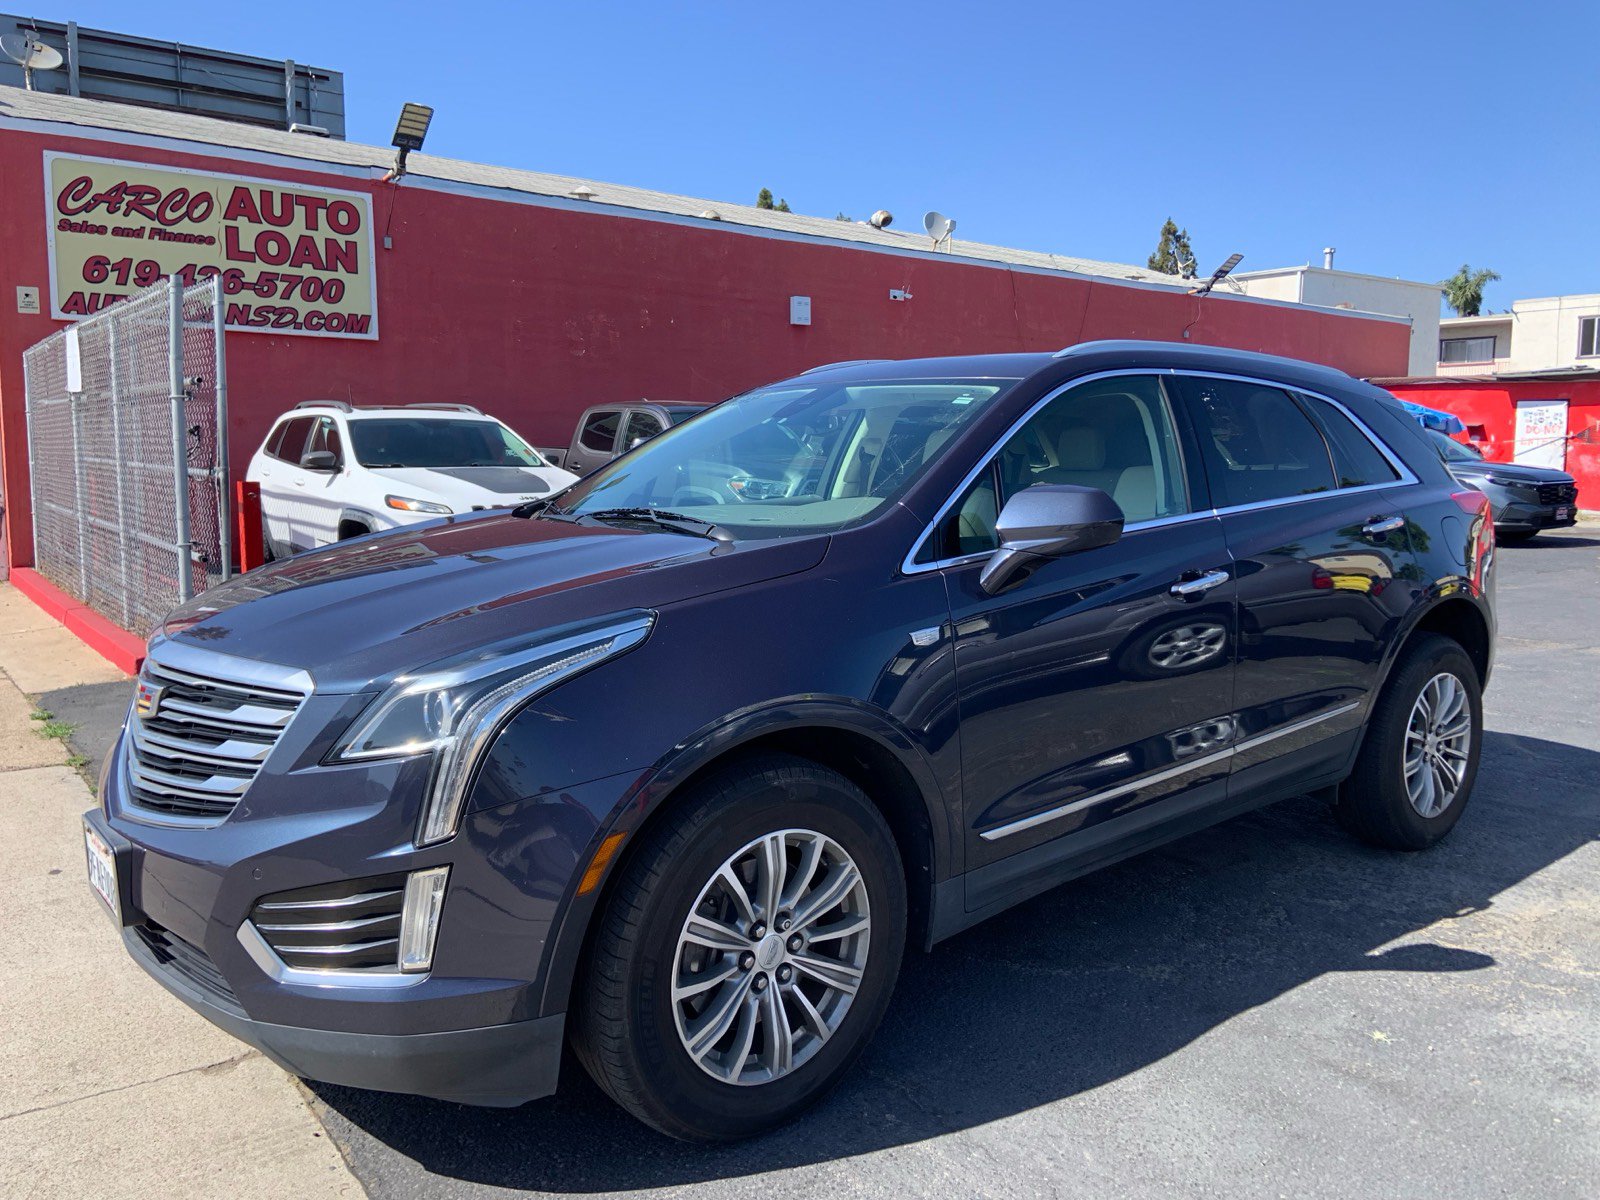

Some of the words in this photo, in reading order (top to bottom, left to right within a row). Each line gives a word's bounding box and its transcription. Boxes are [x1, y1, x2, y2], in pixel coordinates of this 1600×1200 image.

[57, 176, 214, 226] CARCO
[223, 186, 361, 235] AUTO
[57, 218, 108, 235] Sales
[111, 226, 145, 239] and
[148, 227, 216, 246] Finance
[225, 225, 359, 274] LOAN
